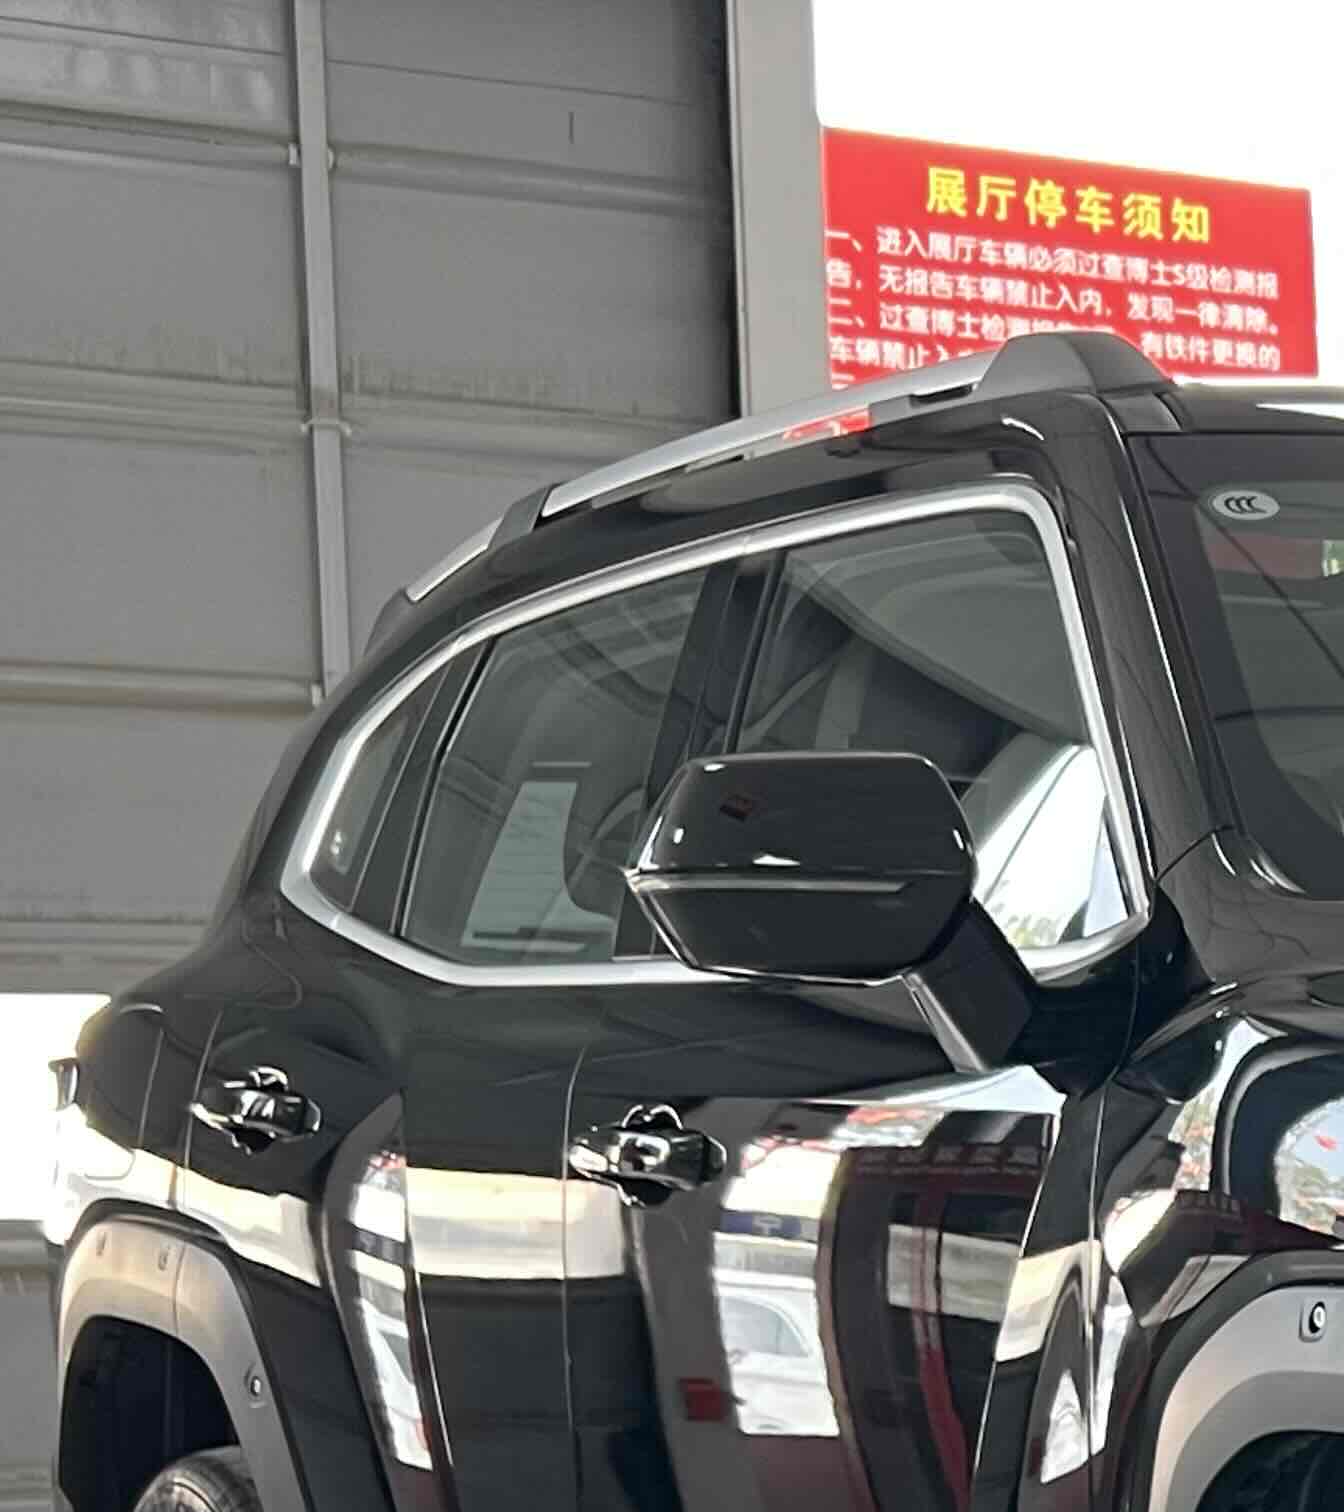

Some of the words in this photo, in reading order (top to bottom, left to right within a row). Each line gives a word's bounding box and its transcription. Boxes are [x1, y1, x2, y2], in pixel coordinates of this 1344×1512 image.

[926, 165, 1211, 243] 展厅停车须知
